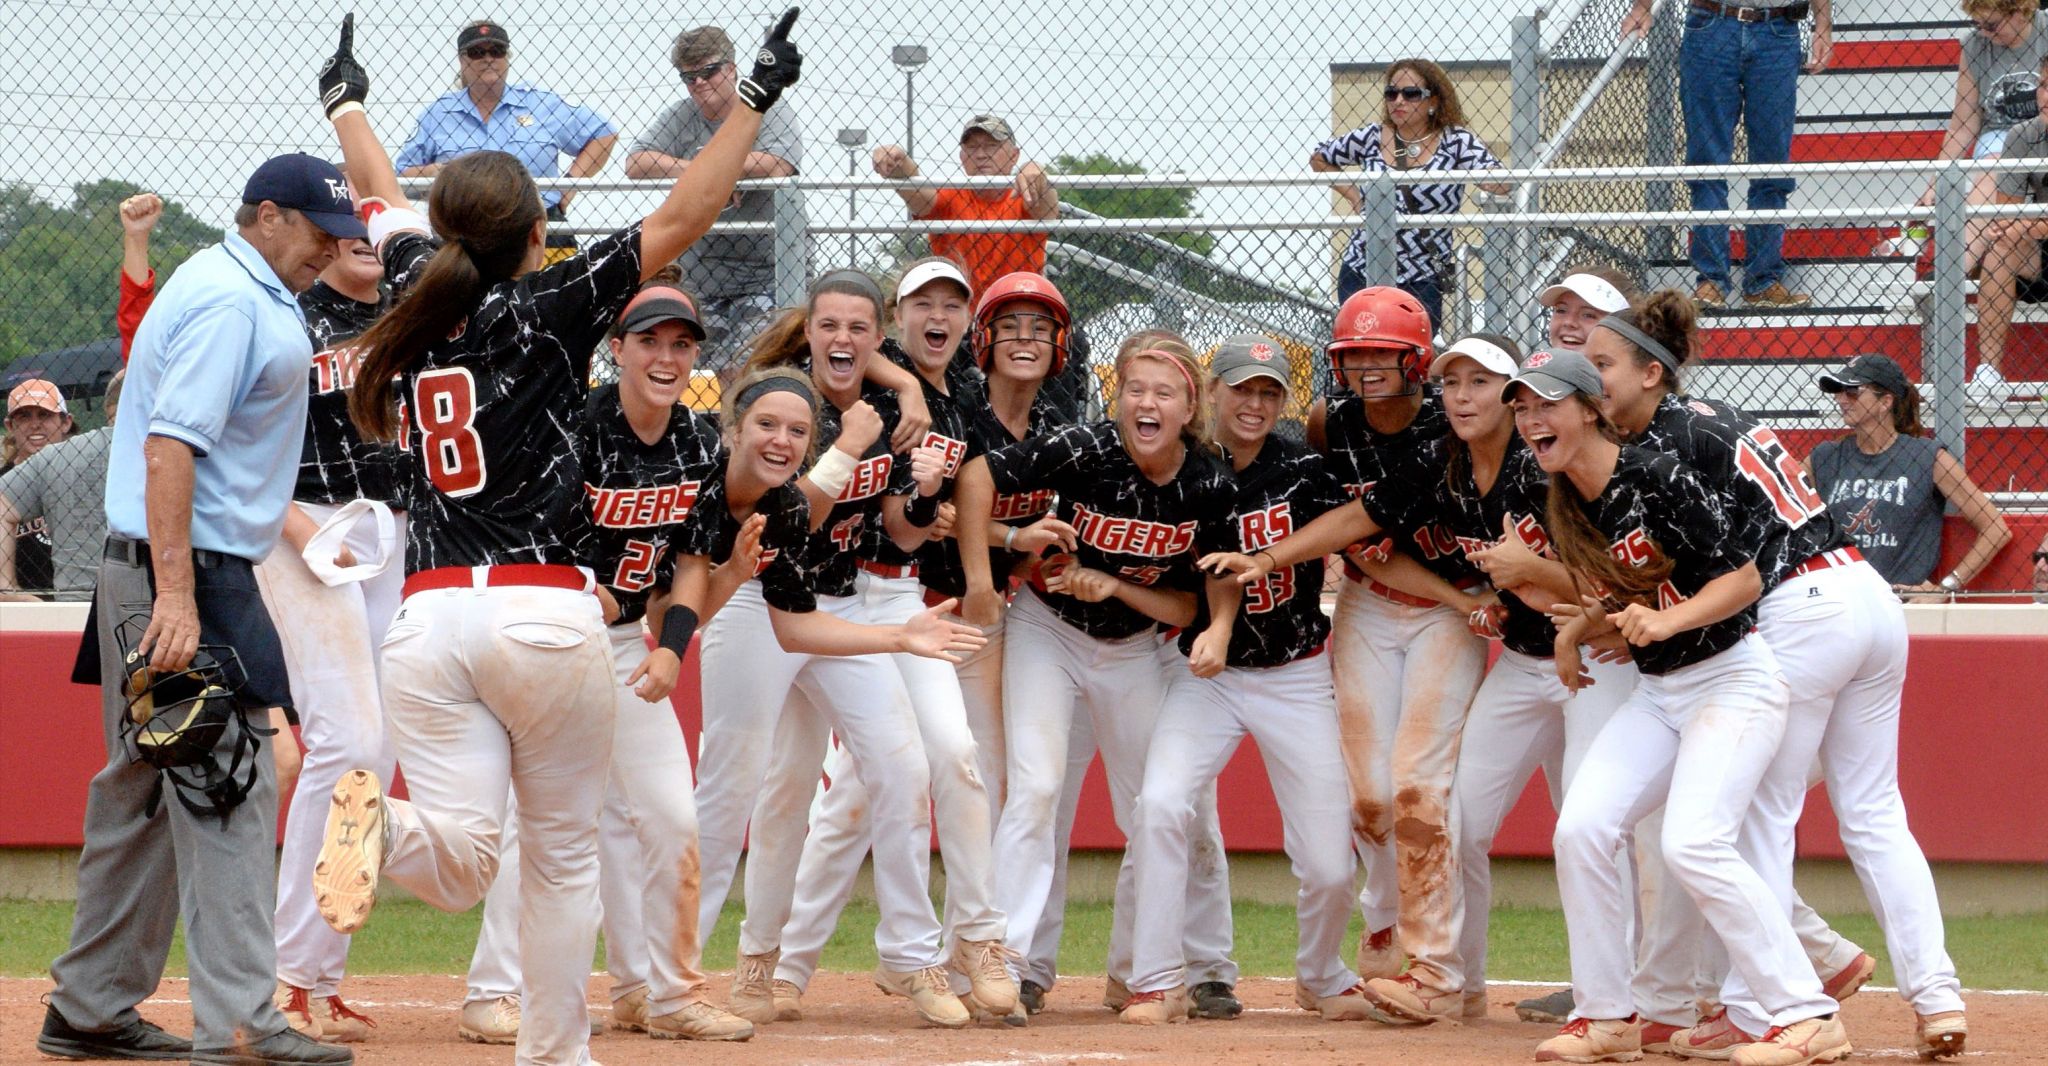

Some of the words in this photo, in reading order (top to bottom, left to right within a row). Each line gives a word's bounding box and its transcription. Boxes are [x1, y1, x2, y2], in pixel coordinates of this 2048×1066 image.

[414, 366, 487, 498] 8
[1734, 424, 1827, 530] 12
[583, 480, 702, 529] TIGERS
[1072, 502, 1199, 558] TIGERS
[1413, 523, 1461, 560] 10
[1246, 564, 1296, 615] 33
